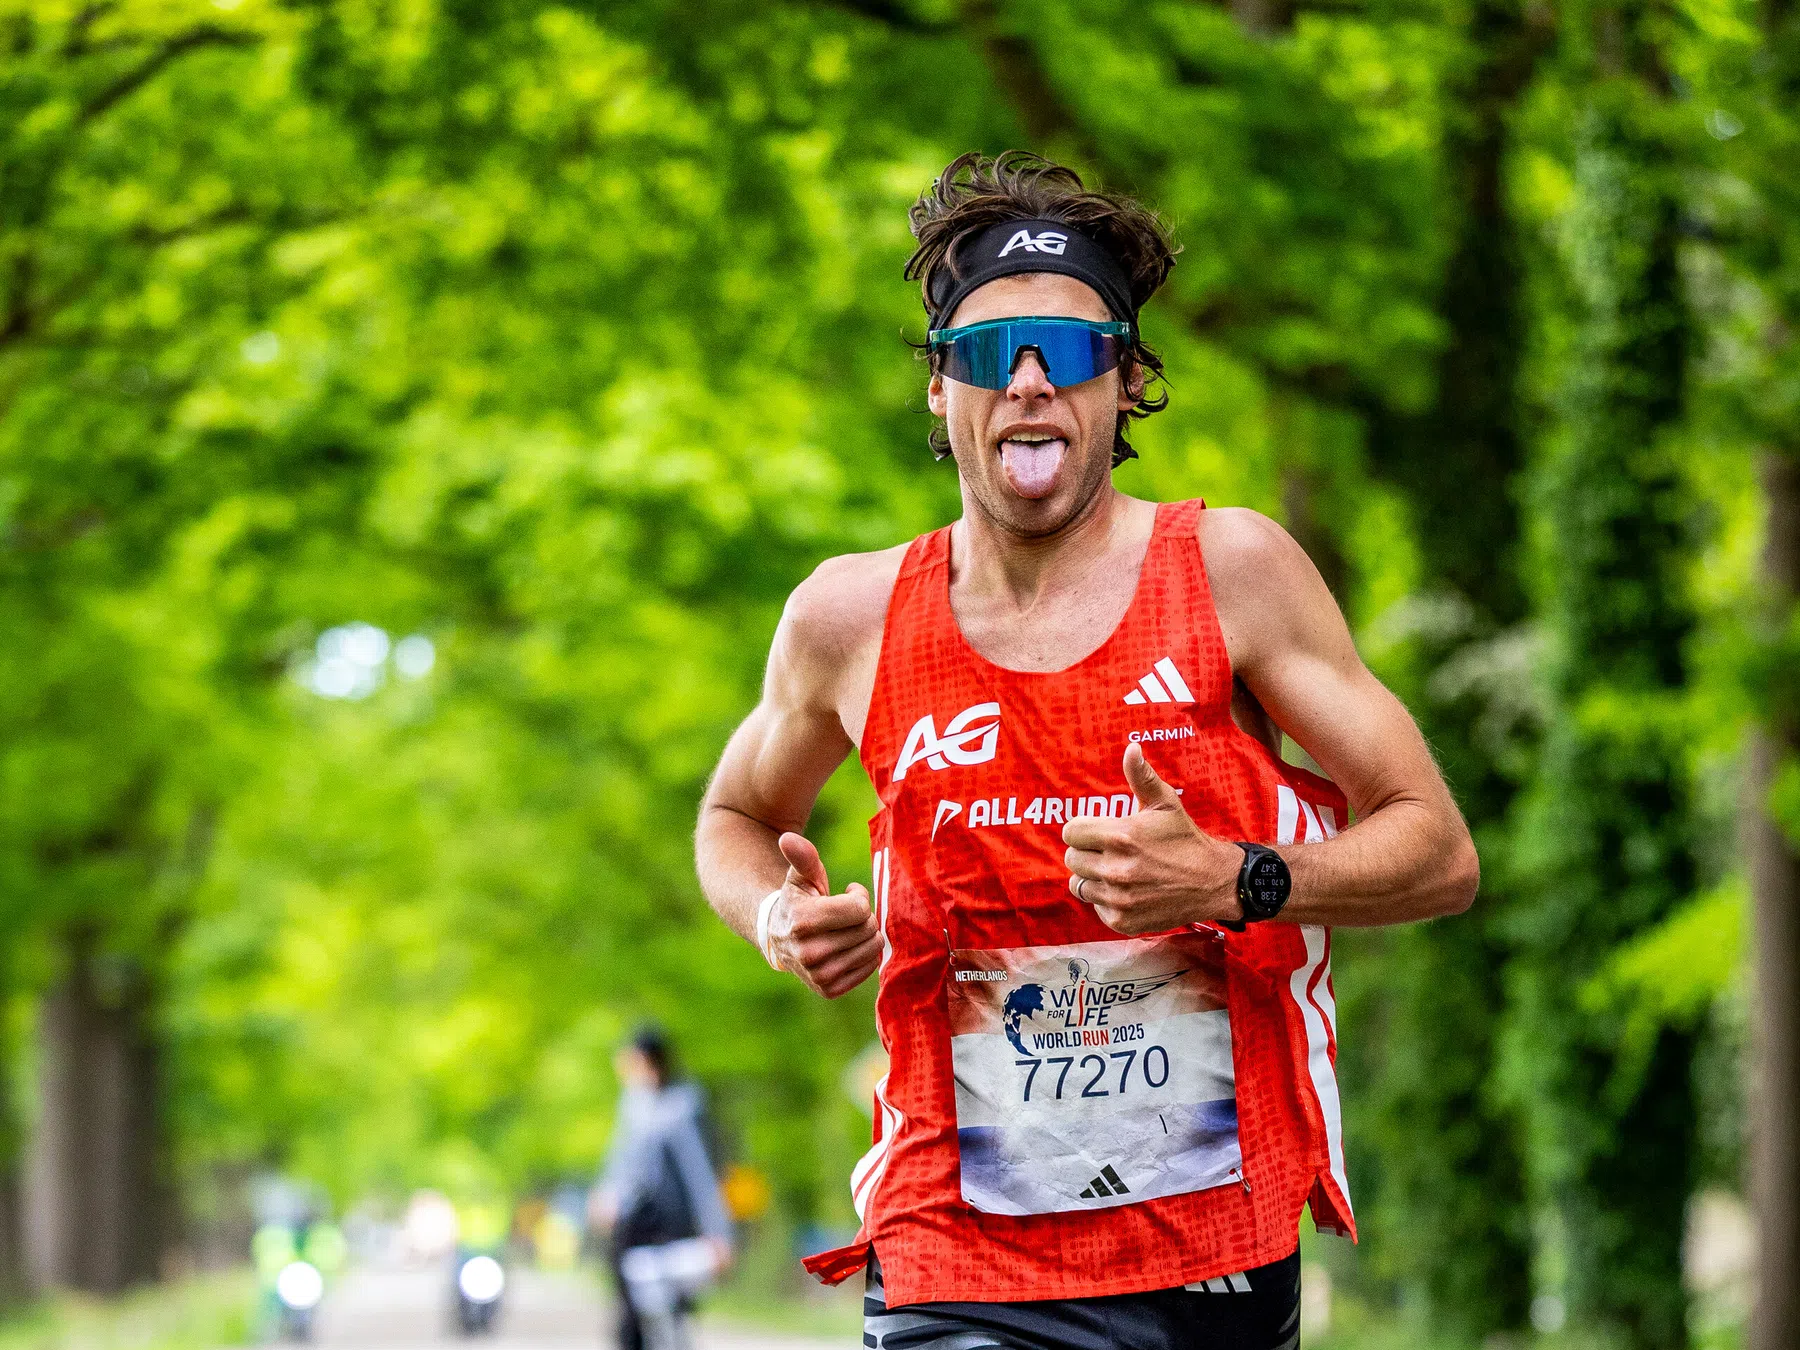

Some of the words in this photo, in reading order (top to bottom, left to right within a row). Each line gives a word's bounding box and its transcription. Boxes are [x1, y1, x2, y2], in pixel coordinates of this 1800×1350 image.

[997, 229, 1068, 258] AG
[892, 701, 1001, 783] AG
[1128, 726, 1196, 743] GARMIN
[955, 970, 1008, 982] NETHERLANDS
[1047, 1010, 1065, 1019] FOR
[1112, 1023, 1145, 1043] 2025
[1015, 1045, 1170, 1102] 77270
